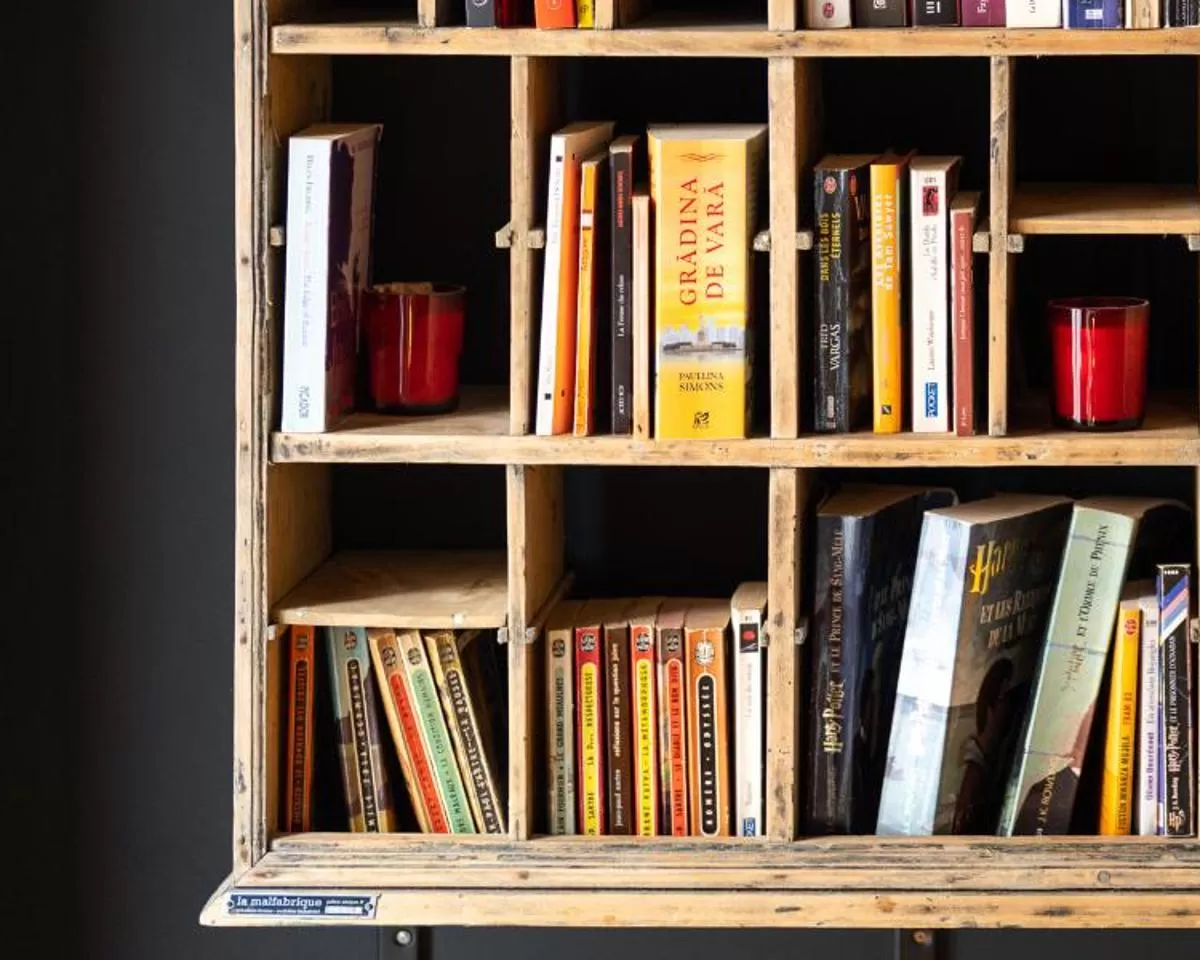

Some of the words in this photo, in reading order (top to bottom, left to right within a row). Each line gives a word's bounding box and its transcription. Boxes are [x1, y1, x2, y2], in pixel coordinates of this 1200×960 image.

[702, 182, 725, 256] VARĂ
[675, 177, 698, 307] GRĂDINA
[705, 263, 725, 300] DE
[819, 323, 830, 349] FRED
[829, 323, 841, 371] VARGAS
[821, 679, 846, 721] Potter
[822, 720, 845, 753] Harry
[445, 778, 461, 815] MALRAUX
[237, 896, 249, 907] la
[250, 896, 323, 910] malfabrique
